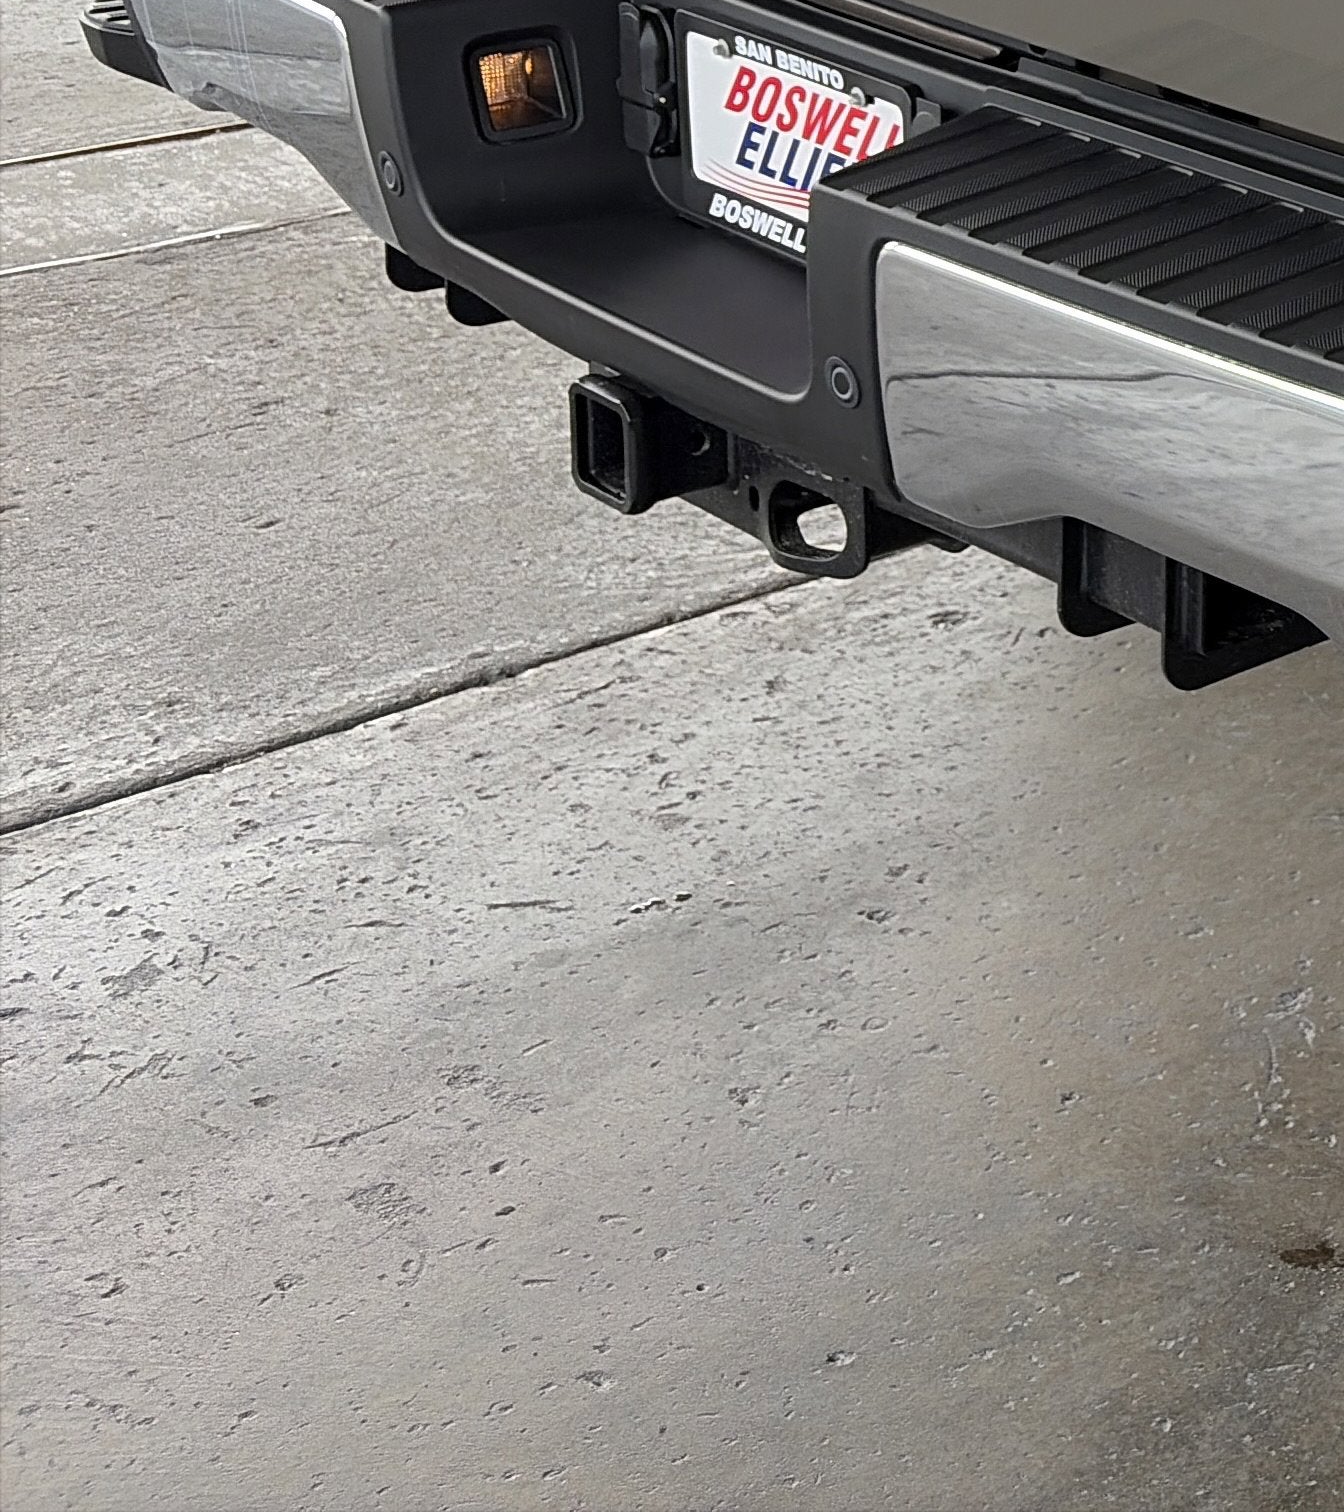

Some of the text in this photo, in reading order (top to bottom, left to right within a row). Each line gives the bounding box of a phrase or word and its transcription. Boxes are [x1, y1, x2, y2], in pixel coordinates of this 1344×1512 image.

[734, 36, 844, 90] SAN BENITO
[708, 193, 807, 253] BOSWELL
